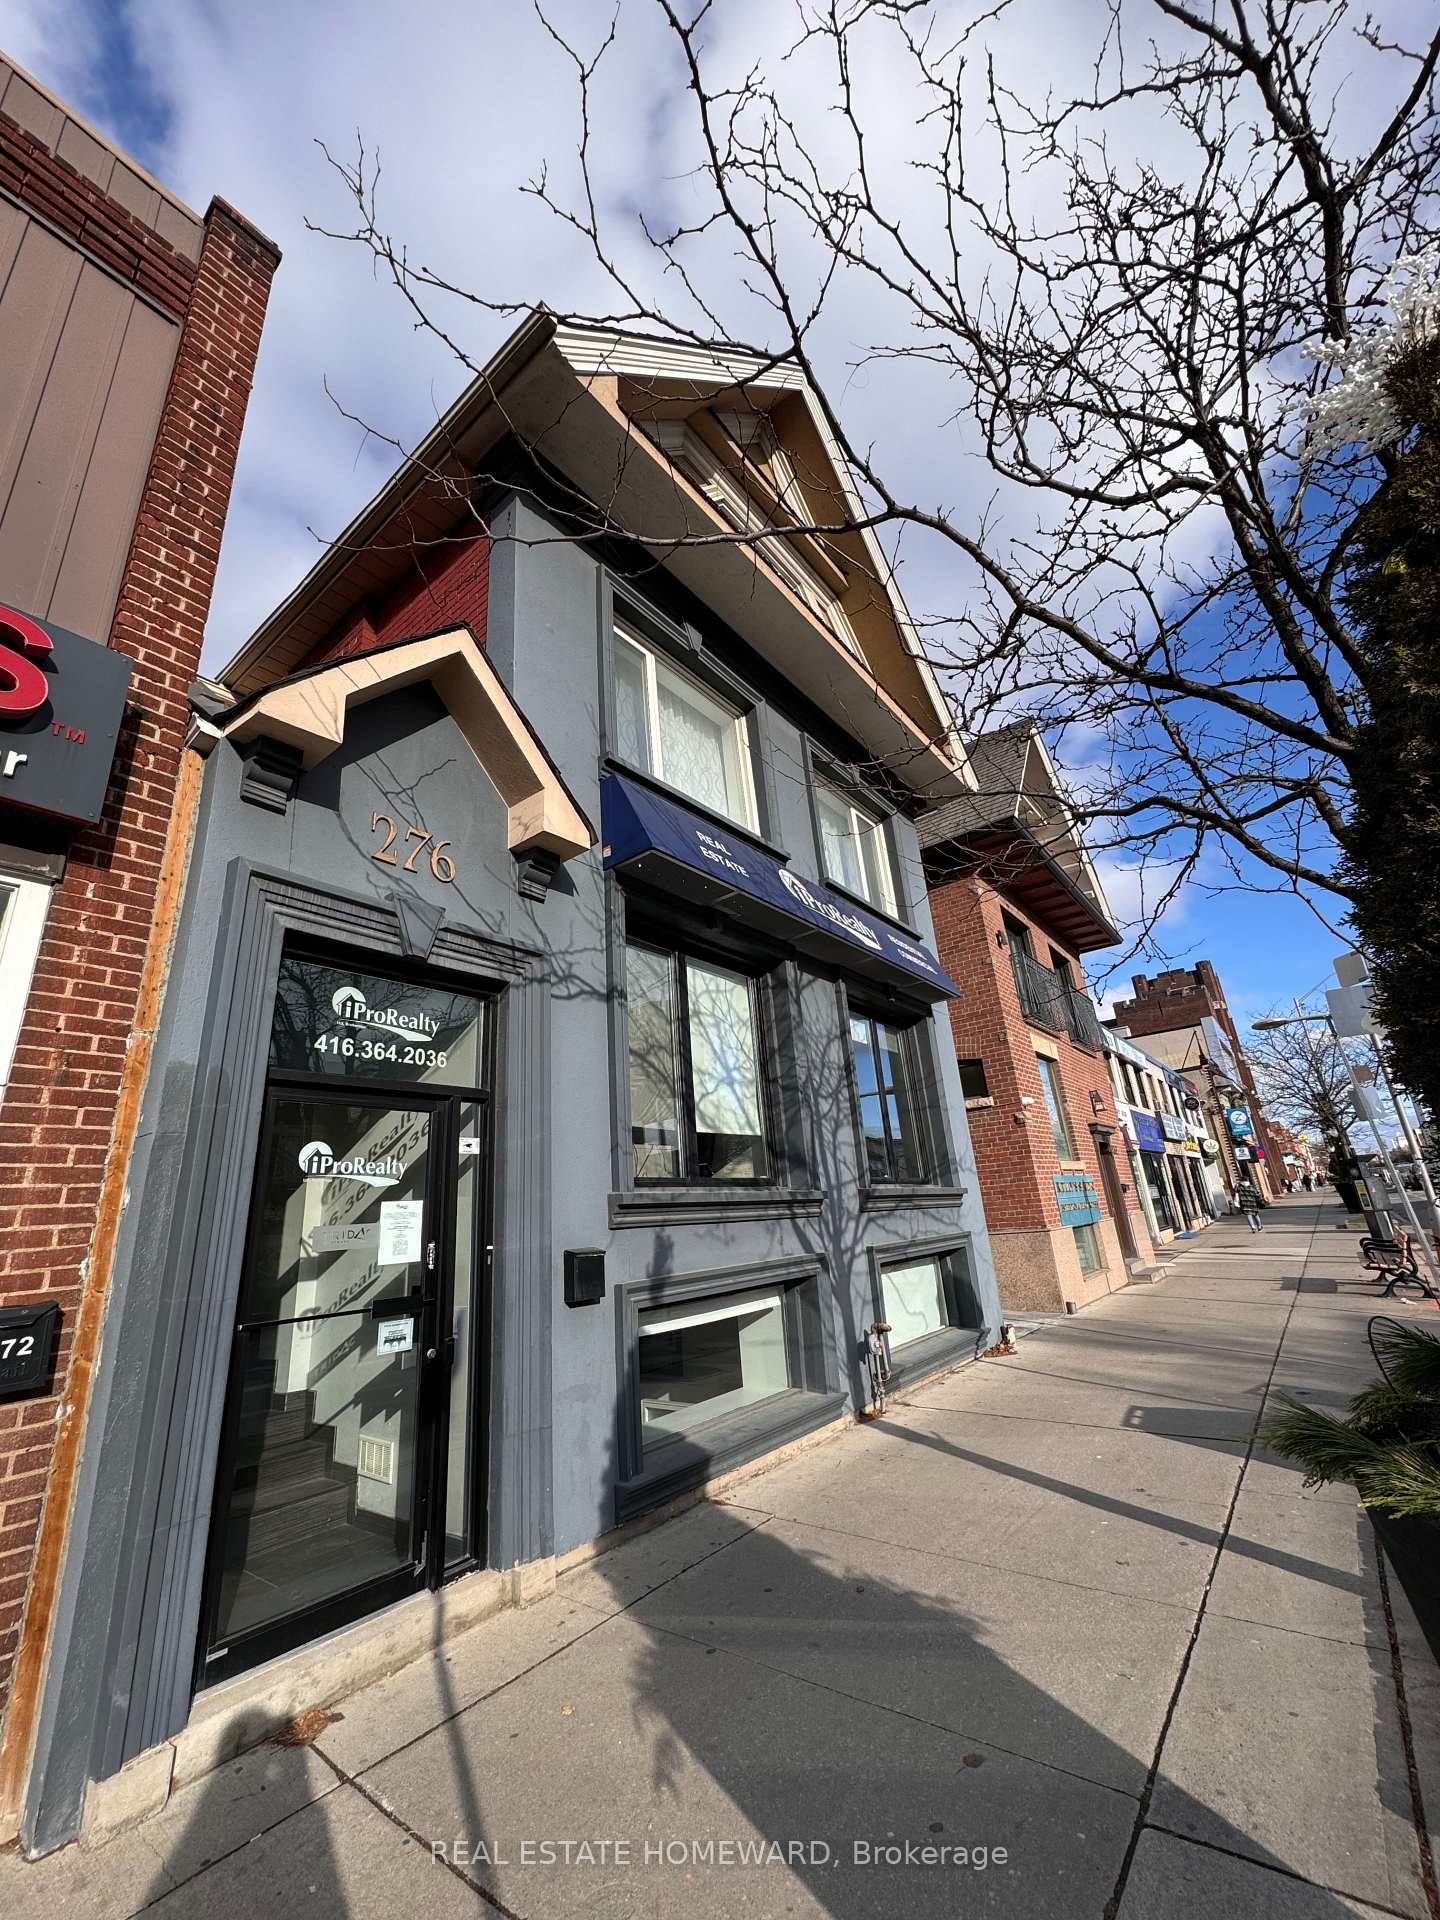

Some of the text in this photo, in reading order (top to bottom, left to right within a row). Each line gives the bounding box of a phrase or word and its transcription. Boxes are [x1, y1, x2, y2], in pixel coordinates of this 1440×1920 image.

[51, 720, 86, 745] TM
[371, 812, 456, 883] 276
[696, 831, 731, 856] REAL
[699, 846, 750, 878] ESTATE
[795, 884, 881, 947] iProRealty
[345, 1001, 440, 1038] iProRealty
[314, 1034, 448, 1068] 416.364.2036
[311, 1156, 408, 1180] iProRealty
[1, 1336, 34, 1359] 72
